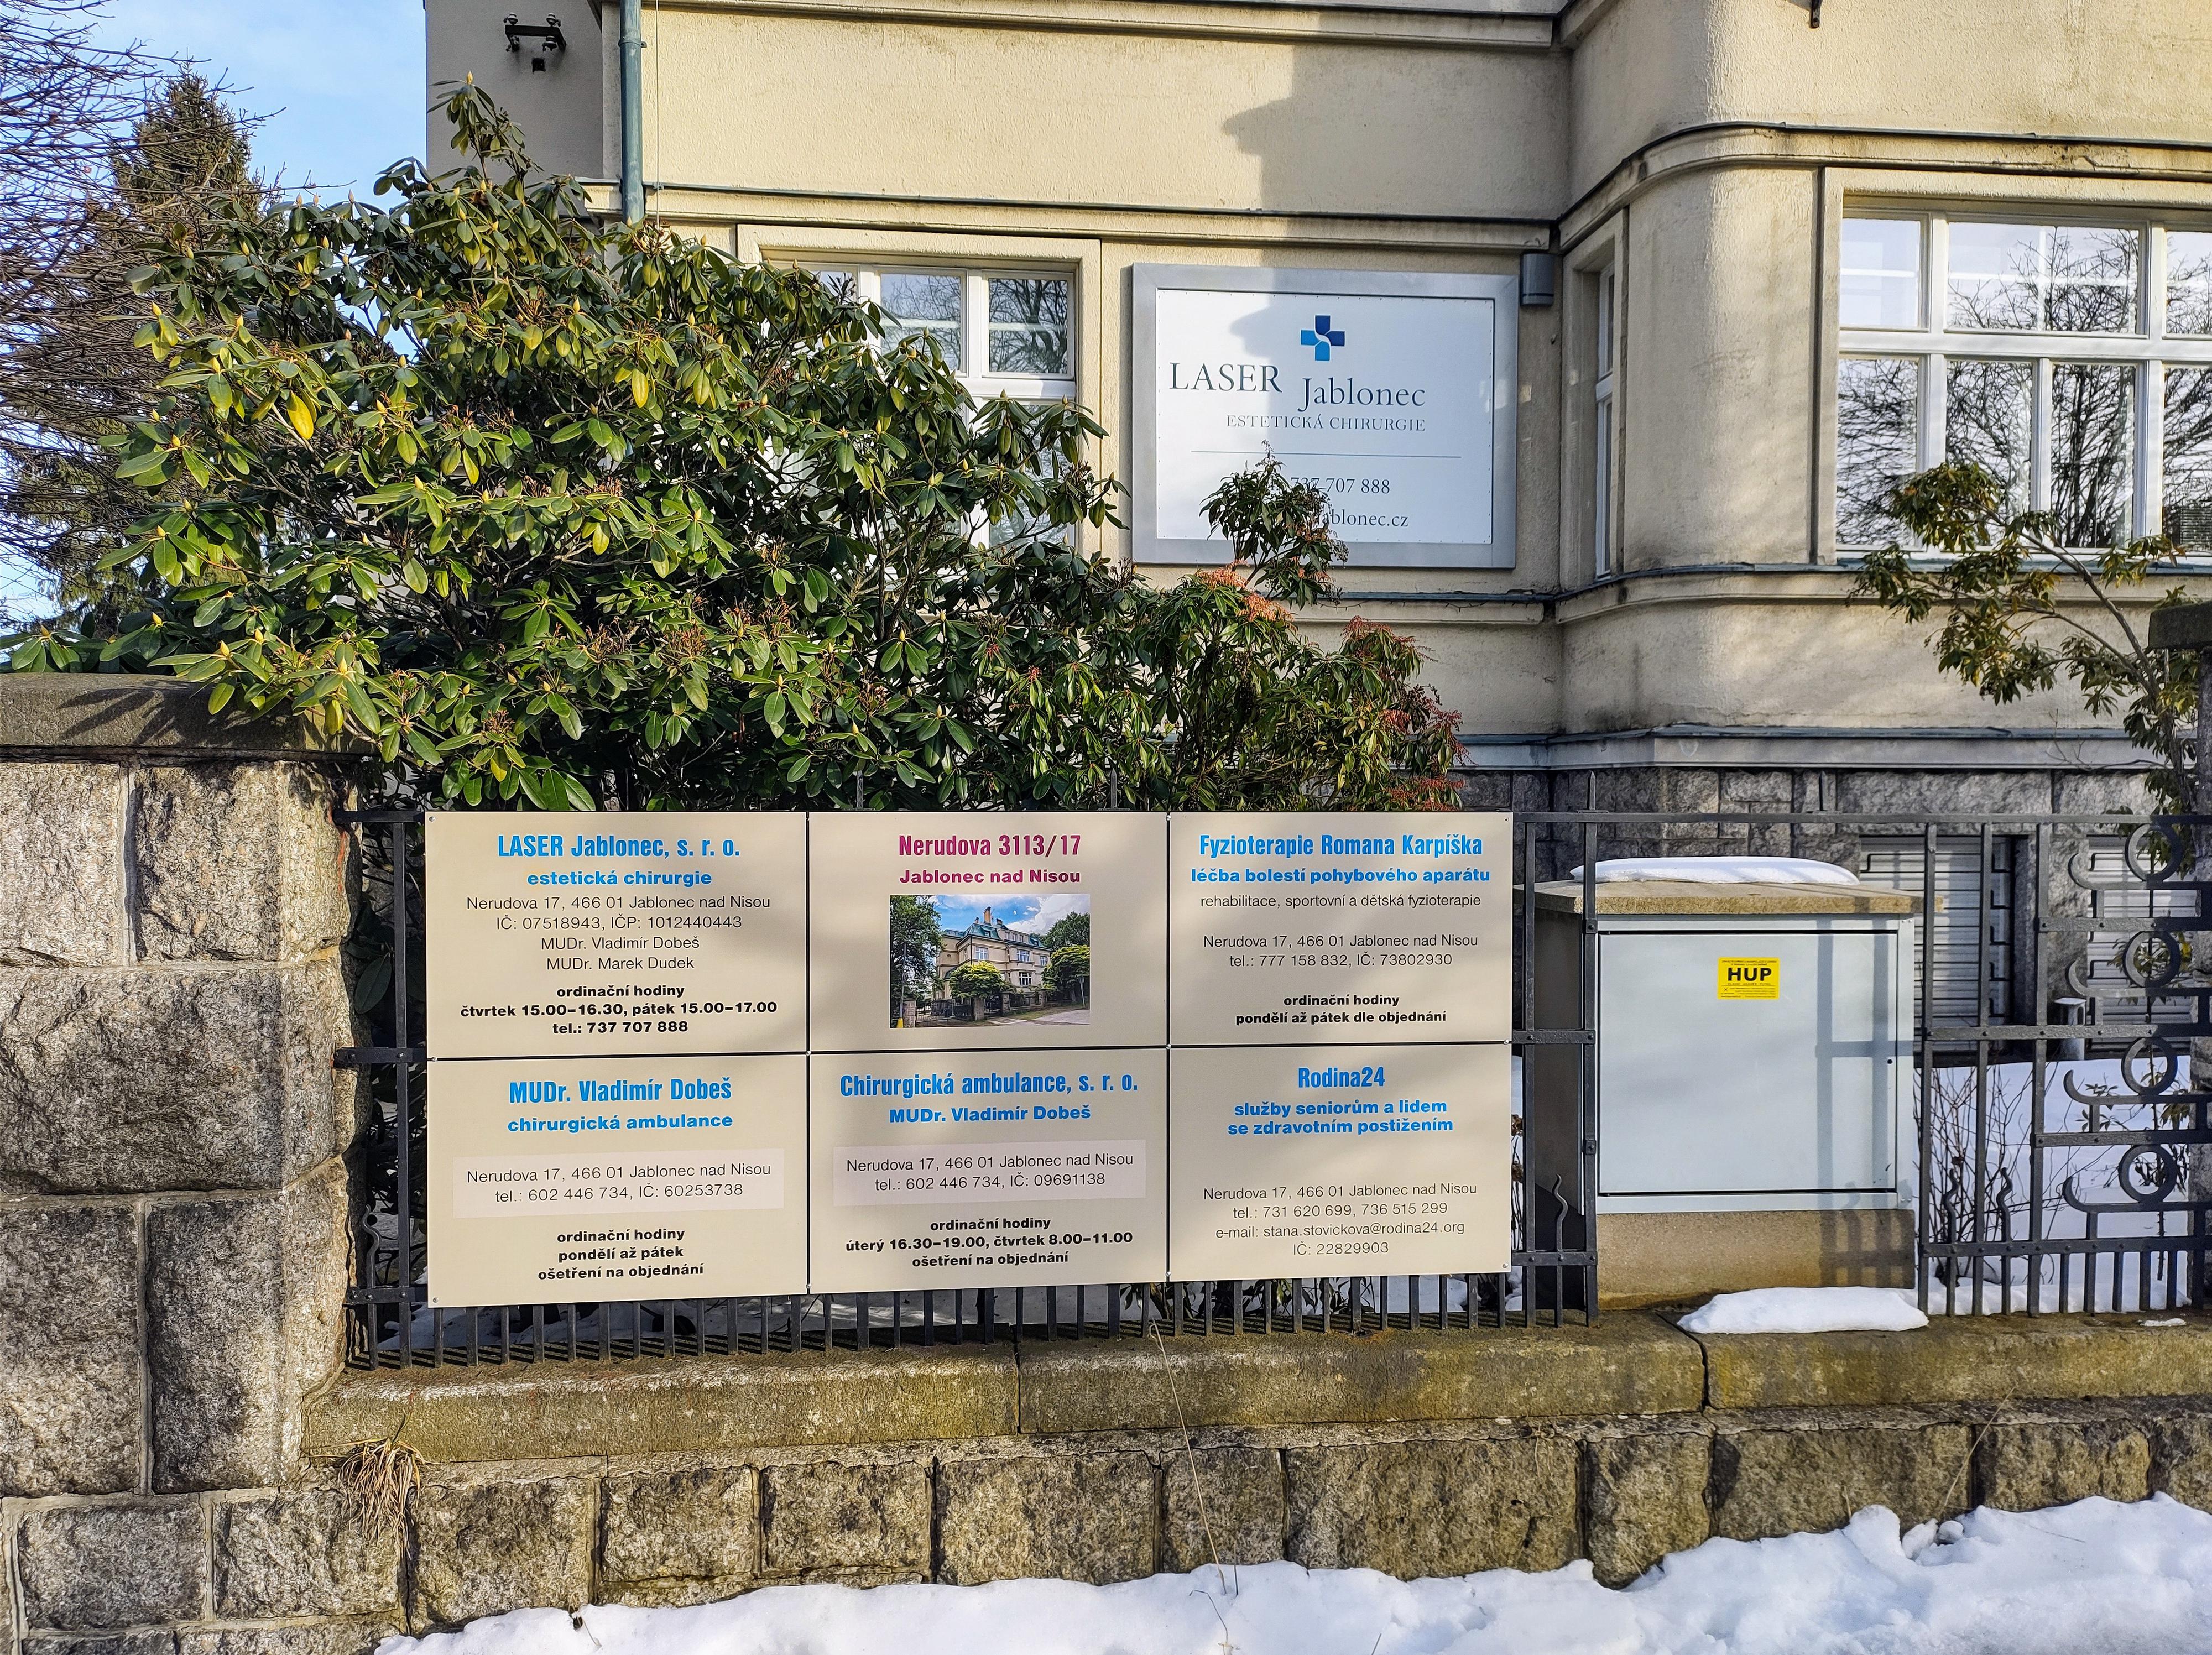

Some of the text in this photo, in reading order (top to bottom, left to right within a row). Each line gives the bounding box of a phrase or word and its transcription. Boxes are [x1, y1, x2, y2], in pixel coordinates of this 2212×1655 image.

[1169, 362, 1425, 412] LASER Jablonec
[1228, 414, 1425, 431] ESTETICKÁ CHIRURGIE
[1326, 478, 1355, 493] 707
[1361, 479, 1390, 494] 888
[498, 835, 739, 859] LASER Jablonec, s. r. o.
[899, 835, 1080, 857] Nerudova 3113/17
[1201, 834, 1482, 858] Fyzioterapie Romana Karpíška
[528, 870, 712, 887] estetická chirurgie
[900, 869, 1079, 883] Jablonec nad Nisou
[1192, 868, 1490, 884] léčba bolestí pohybového aparátu
[467, 896, 770, 911] Nerudova 17, 466 01 Jablonec nad Nisou
[1201, 894, 1480, 909] rehabilitace, sportovní a dětská fyzioterapie
[497, 914, 741, 931] IČ: 07518943, IČP: 1012440443
[542, 936, 699, 949] MUDr. Vladimír Dobeš
[1204, 934, 1477, 949] Nerudova 17, 466 01 Jablonec nad Nisou
[547, 957, 695, 970] MUDr. Marek Dudek
[1230, 951, 1452, 968] tel.: 777 158 832, IČ: 73802930
[1728, 967, 1772, 981] HUP
[557, 985, 685, 998] ordinační hodiny
[1284, 994, 1399, 1006] ordinační hodiny
[461, 1005, 516, 1017] čtvrtek
[633, 1003, 675, 1016] pátek
[1237, 1011, 1446, 1026] pondělí až pátek dle objednání
[552, 1021, 688, 1033] tel.: 737 707 888
[841, 1072, 1137, 1098] Chirurgická ambulance, s. r. o.
[1298, 1067, 1385, 1088] Rodina24
[510, 1077, 731, 1103] MUDr. Vladimír Dobeš
[890, 1105, 1091, 1123] MUDr. Vladimír Dobeš
[1235, 1099, 1447, 1118] služby seniorům a lidem
[508, 1114, 733, 1133] chirurgická ambulance
[1228, 1118, 1453, 1135] se zdravotním postižením
[847, 1153, 1133, 1171] Nerudova 17, 466 01 Jablonec nad Nisou
[468, 1163, 770, 1183] Nerudova 17, 466 01 Jablonec nad Nisou
[875, 1173, 1105, 1191] tel.: 602 446 734, IČ: 09691138
[495, 1183, 743, 1202] tel.: 602 446 734, IČ: 60253738
[1204, 1183, 1476, 1199] Nerudova 17, 466 01 Jablonec nad Nisou
[1233, 1203, 1447, 1218] tel.: 731 620 699, 736 515 299
[931, 1218, 1051, 1230] ordinační hodiny
[1216, 1221, 1464, 1238] e-mail: stana.stovickova@rodina24.org
[557, 1229, 685, 1242] ordinační hodiny
[846, 1239, 884, 1252] úterý
[994, 1235, 1045, 1246] čtvrtek
[559, 1246, 684, 1263] pondělí až pátek
[1294, 1241, 1388, 1255] IČ: 22829903
[912, 1254, 972, 1267] ošetření
[998, 1251, 1068, 1266] objednání
[538, 1263, 703, 1280] ošetření na objednání
